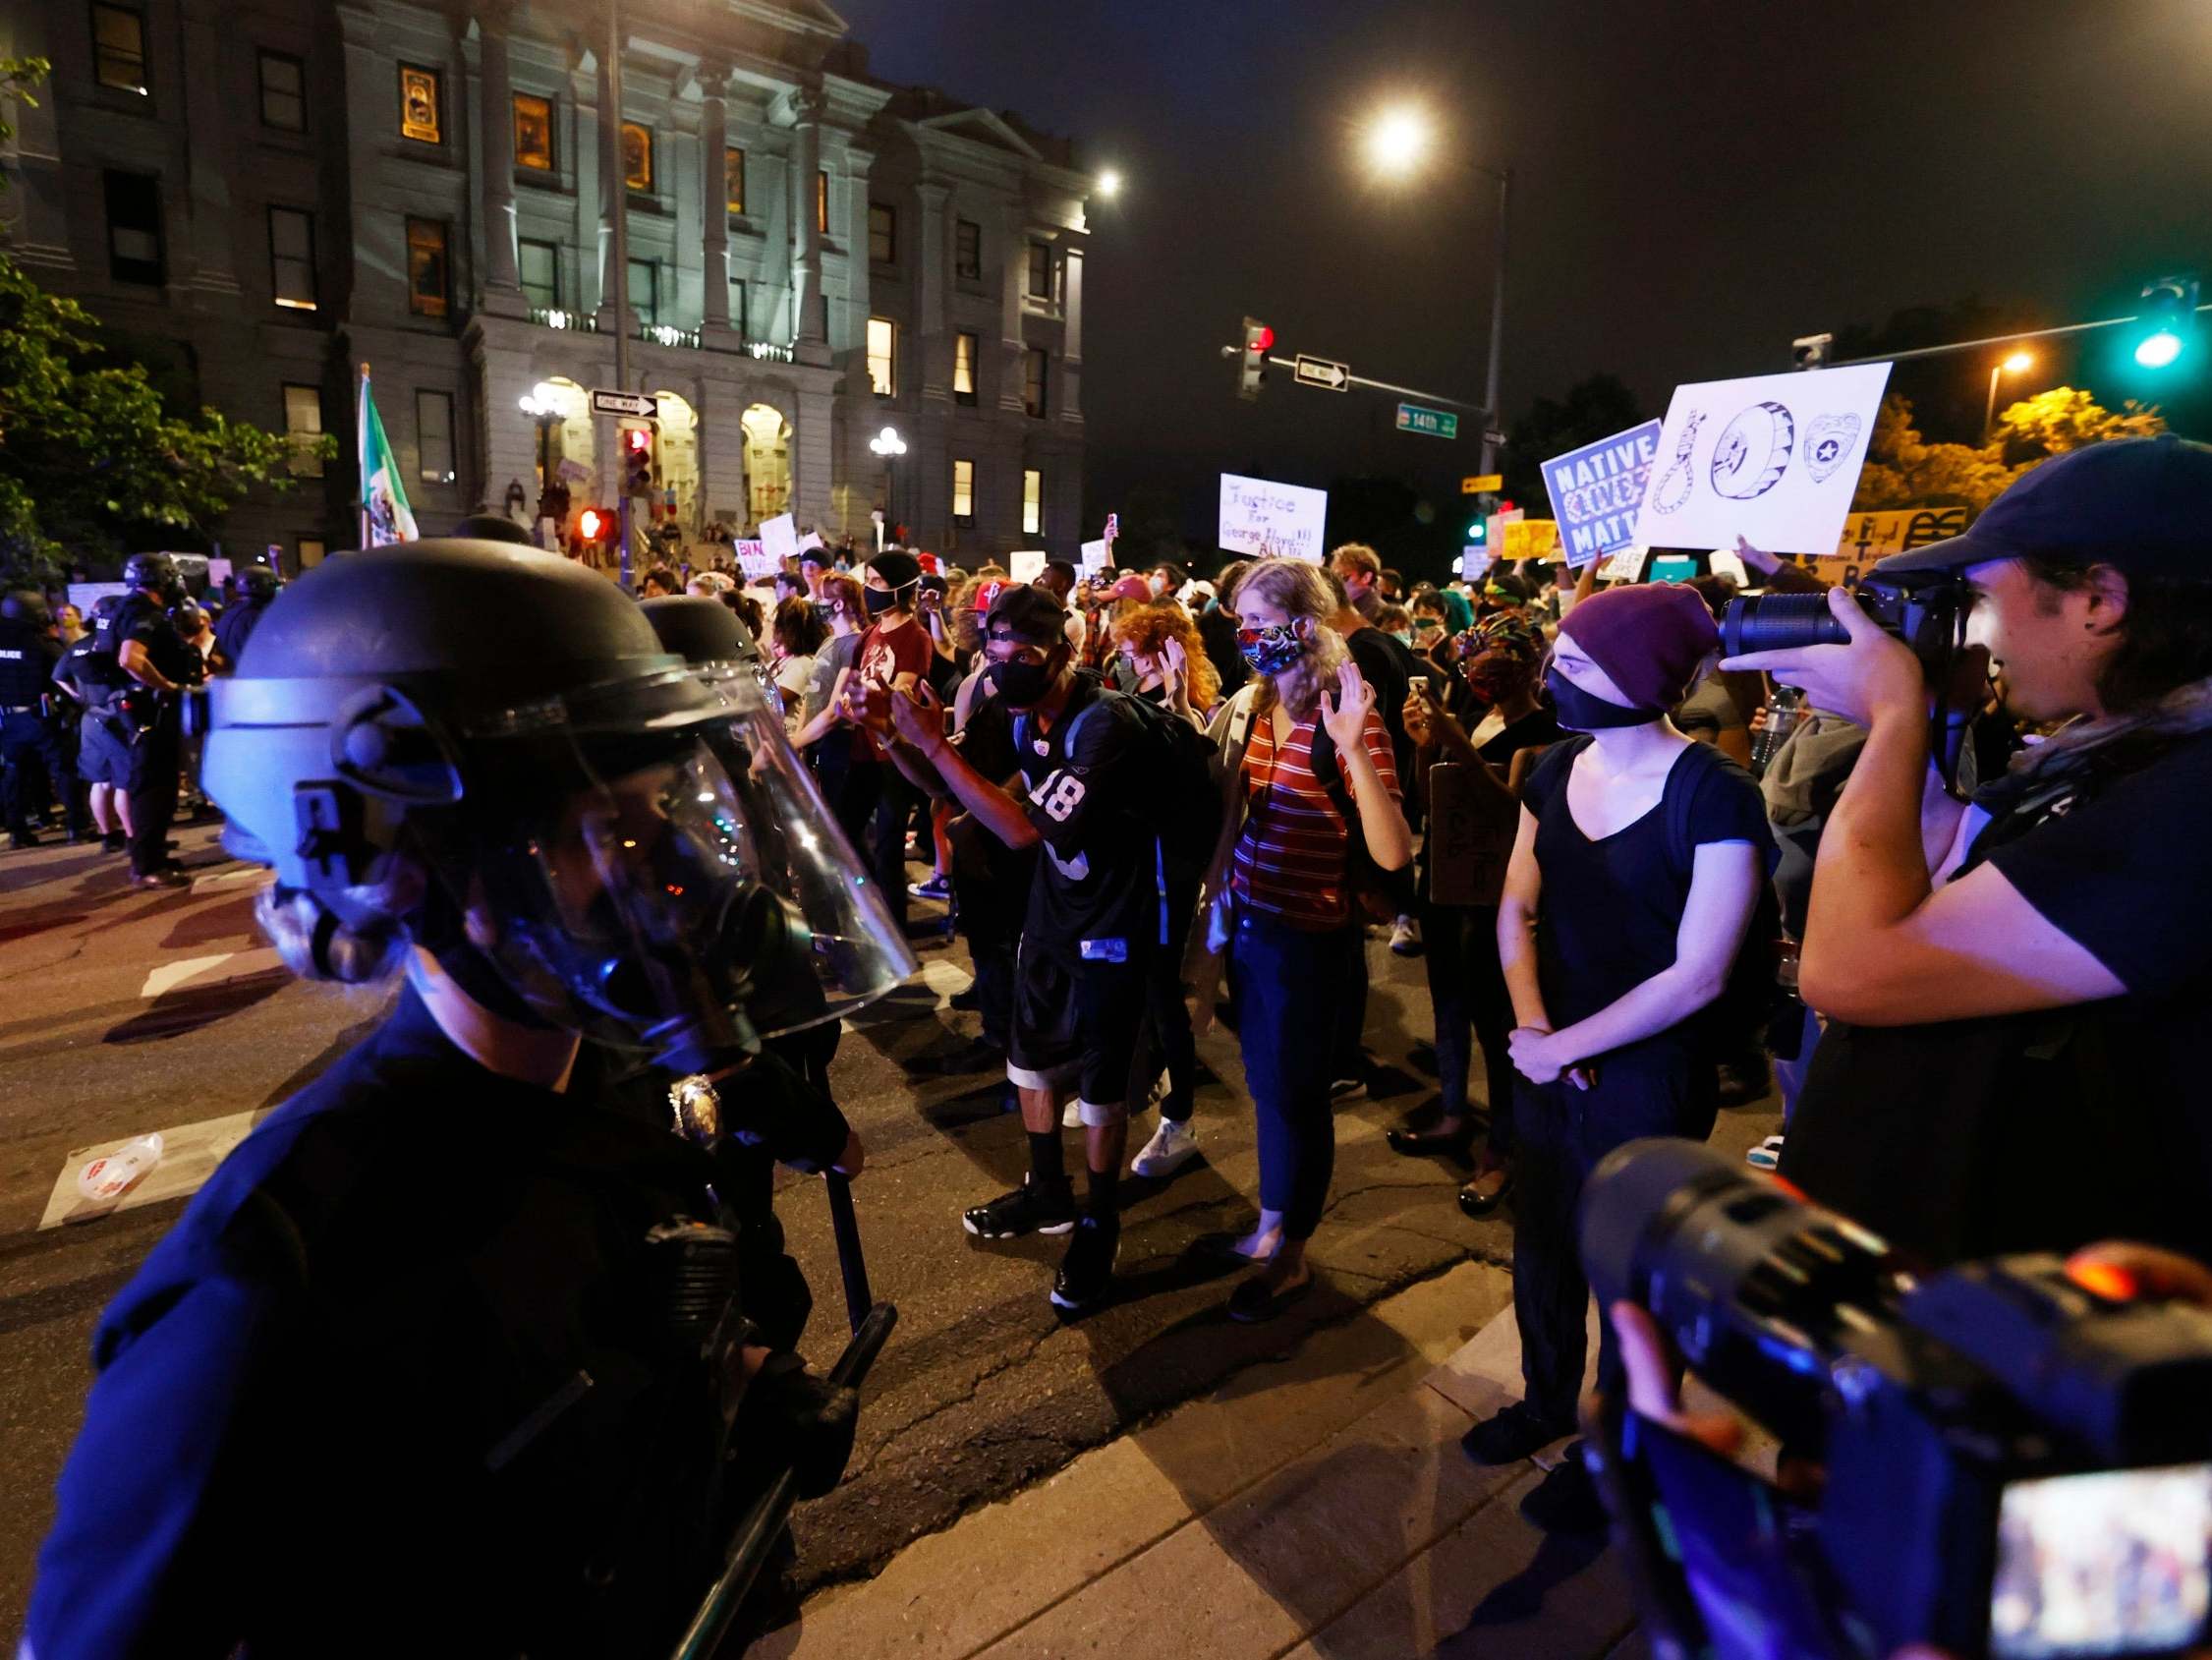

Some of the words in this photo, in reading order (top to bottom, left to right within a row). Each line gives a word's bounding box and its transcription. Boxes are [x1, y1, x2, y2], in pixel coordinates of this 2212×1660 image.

[597, 395, 620, 407] ONE
[621, 400, 640, 410] WAY
[1413, 412, 1437, 430] 14th
[1555, 434, 1653, 494] NATIVE
[1227, 484, 1295, 512] Justice
[1572, 510, 1636, 553] MATT
[1029, 769, 1086, 822] 18
